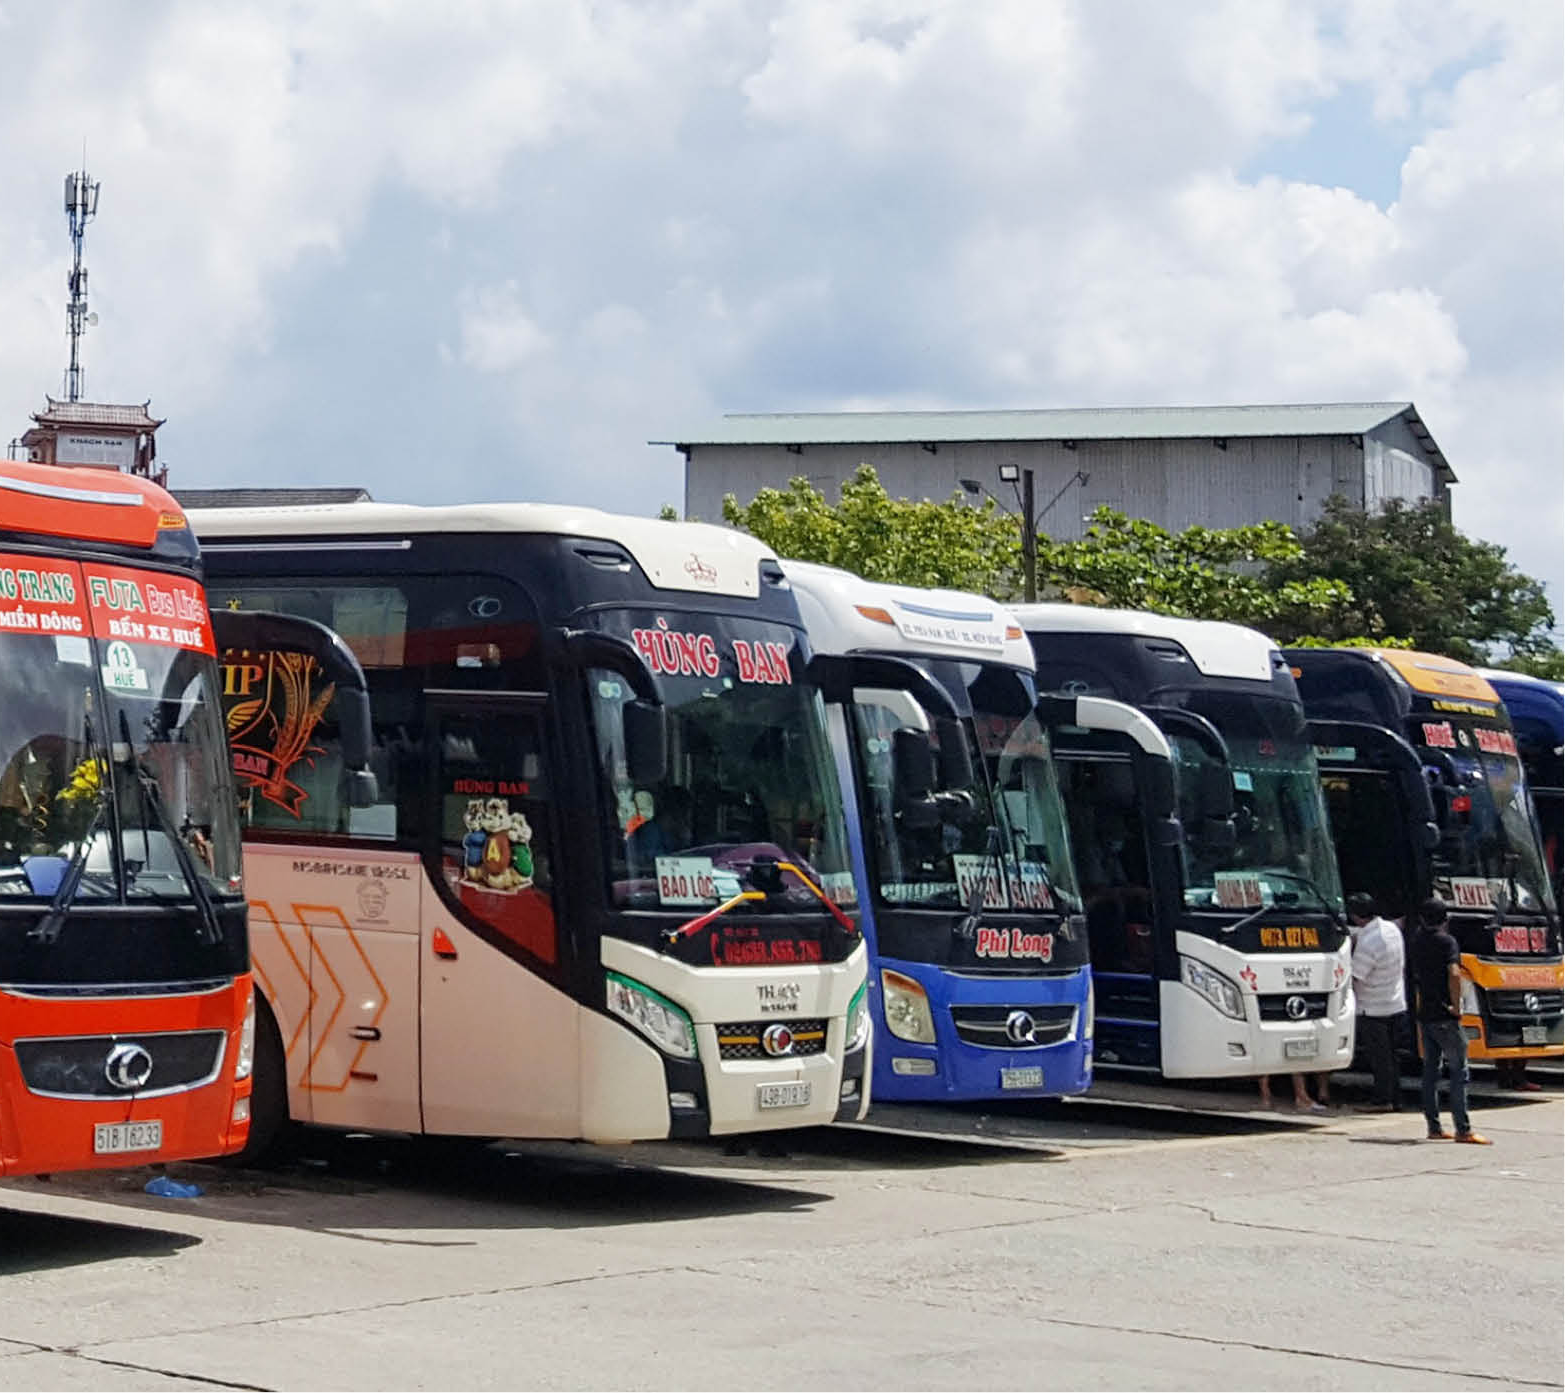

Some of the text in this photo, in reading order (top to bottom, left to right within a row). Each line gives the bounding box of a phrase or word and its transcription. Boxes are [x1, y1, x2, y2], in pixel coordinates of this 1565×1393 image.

[17, 569, 77, 605] TRANG
[88, 575, 147, 613] FUTA
[109, 615, 204, 648] BẾN XE HUẾ
[114, 646, 131, 667] 13
[732, 640, 792, 685] BAN
[218, 664, 264, 695] IP
[975, 927, 1053, 963] Phi Long
